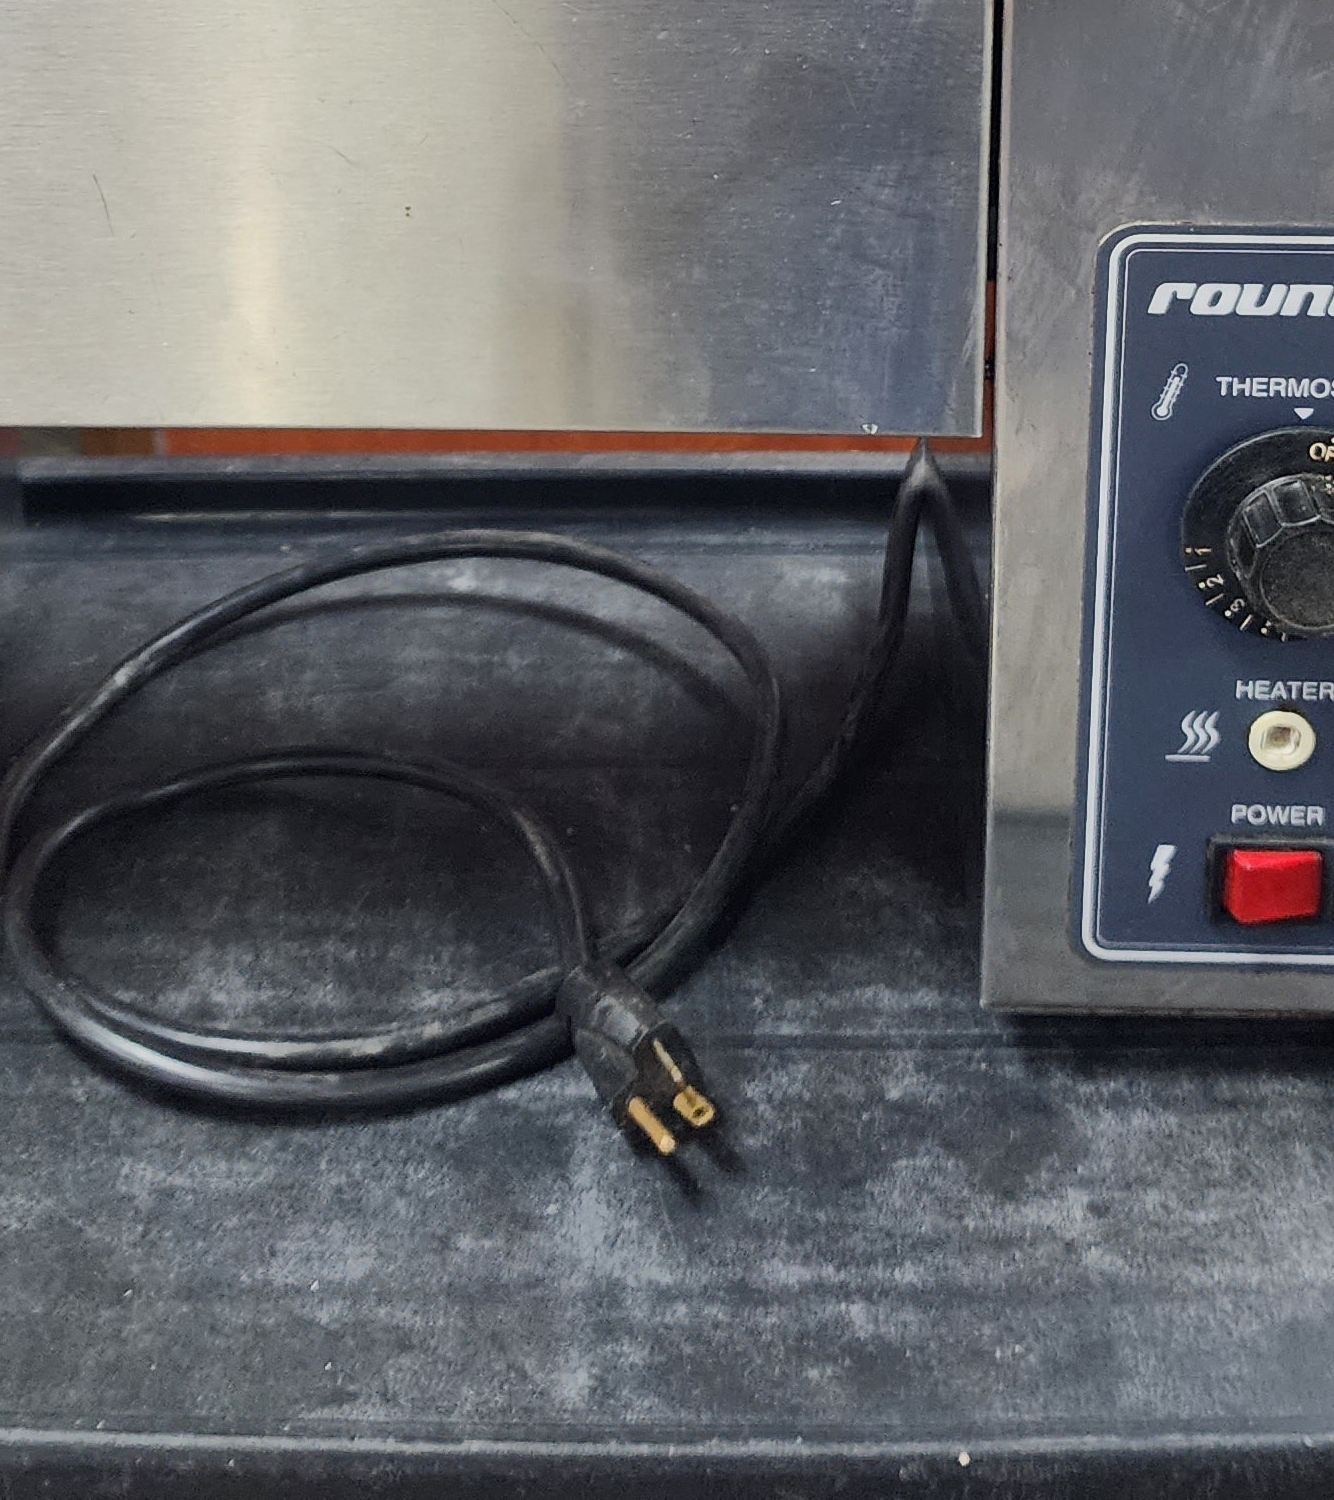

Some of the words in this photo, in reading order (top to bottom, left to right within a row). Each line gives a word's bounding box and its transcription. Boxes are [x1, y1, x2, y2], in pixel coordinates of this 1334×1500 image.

[1194, 546, 1212, 556] 1
[1206, 573, 1225, 590] 2
[1230, 598, 1246, 614] 3
[1230, 804, 1325, 826] POWER
